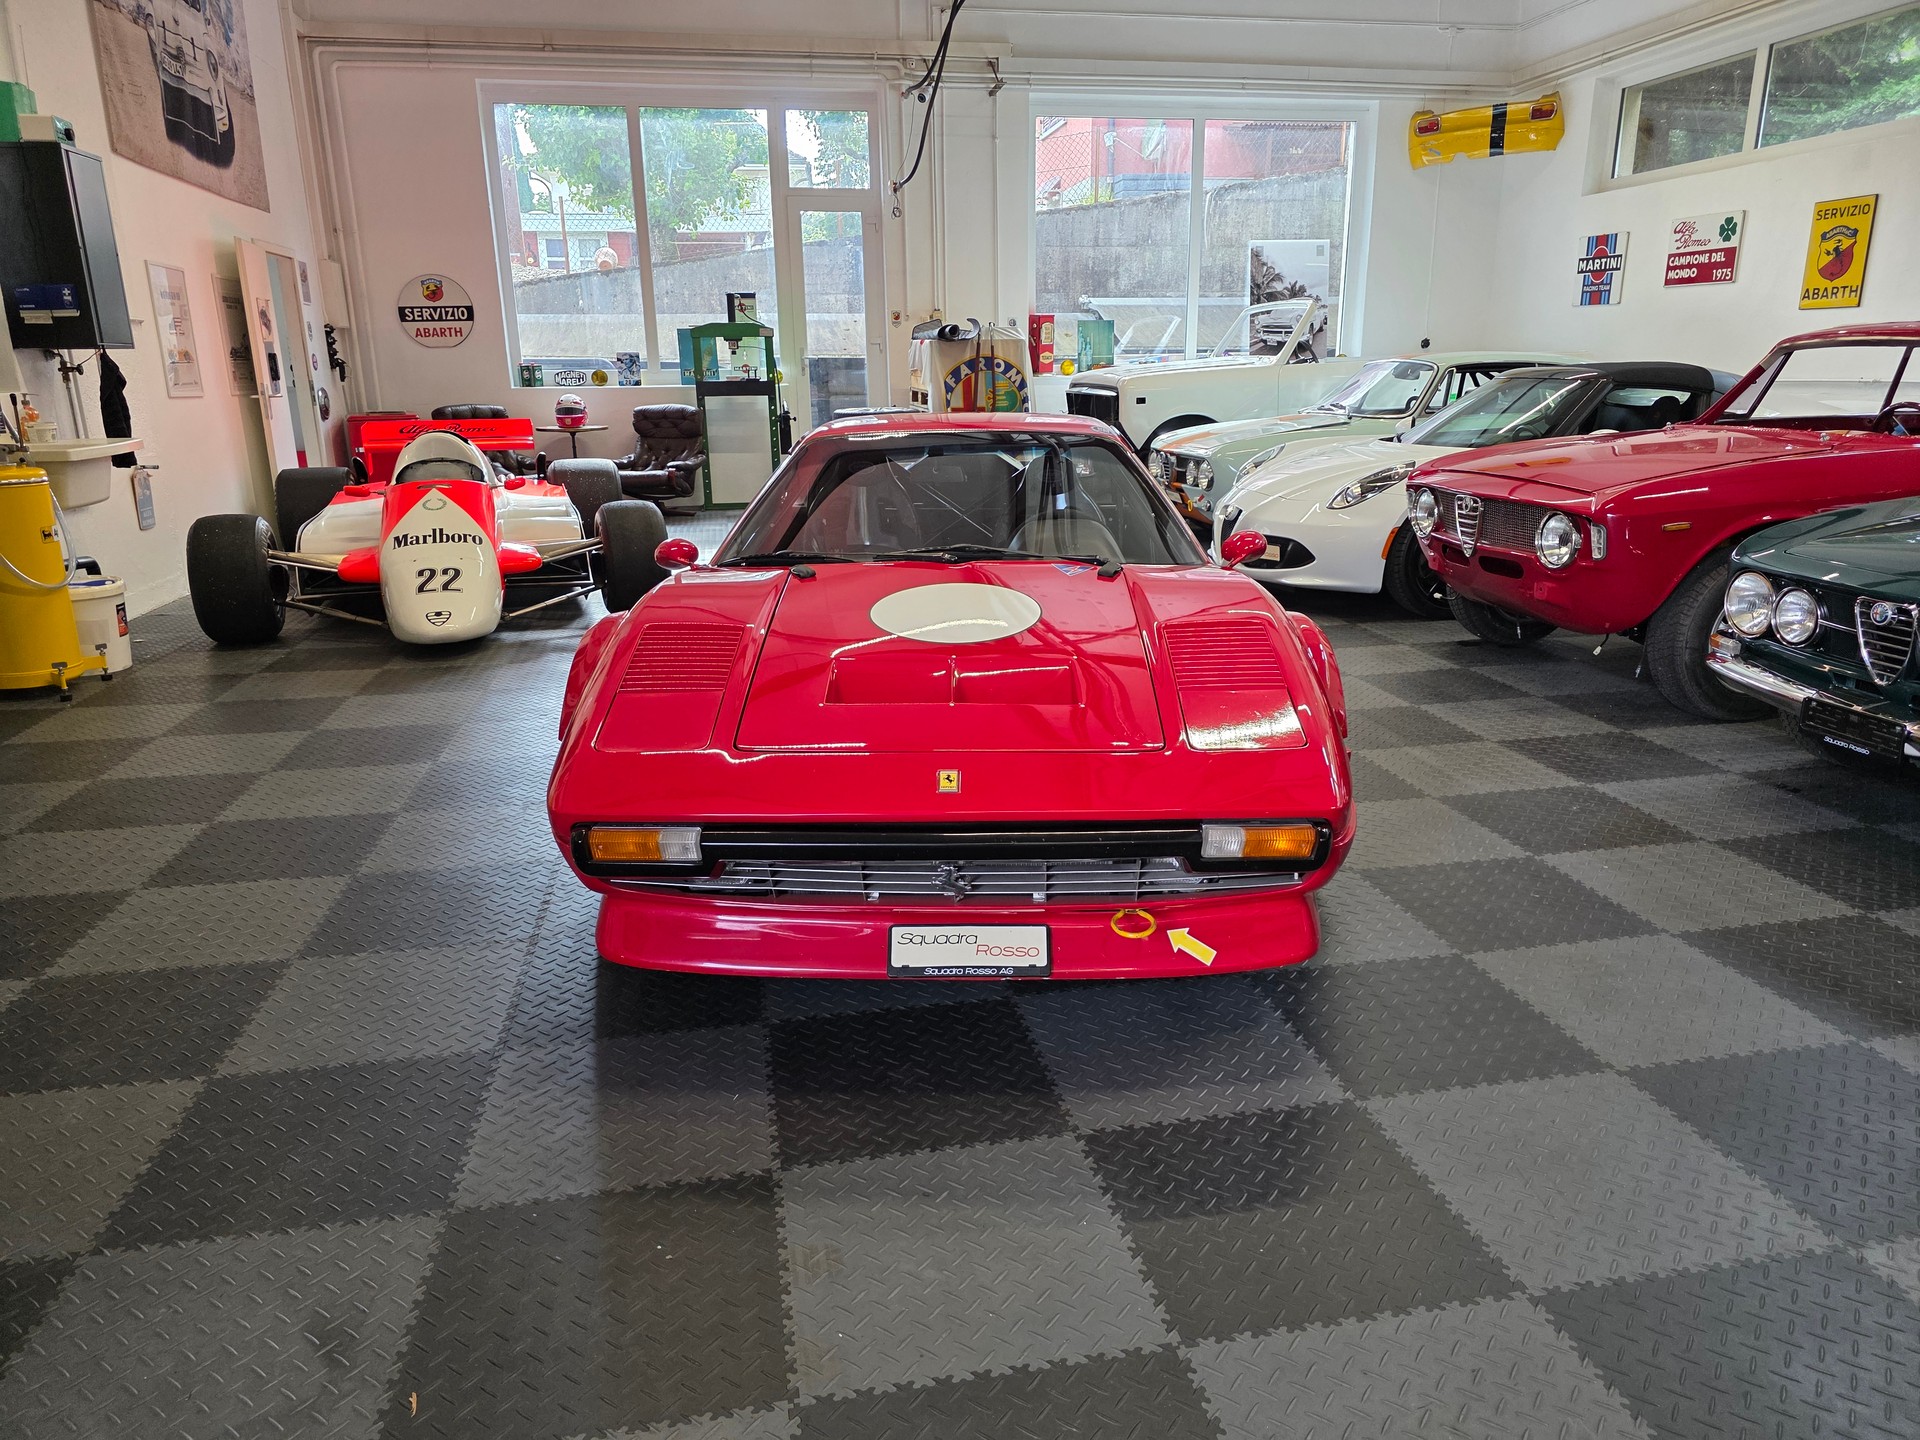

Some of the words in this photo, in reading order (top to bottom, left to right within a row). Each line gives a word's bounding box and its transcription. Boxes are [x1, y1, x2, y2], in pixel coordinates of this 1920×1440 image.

[1816, 203, 1871, 221] SERVIZIO
[1673, 221, 1699, 236] Alfa
[1674, 233, 1711, 250] Romeo
[1578, 255, 1622, 272] MARTINI
[1669, 253, 1710, 267] CAMPIONE
[1711, 251, 1726, 263] DEL
[1667, 267, 1697, 280] MONDO
[1712, 268, 1732, 281] 1975
[1801, 284, 1859, 301] ABARTH
[404, 307, 468, 321] SERVIZIO
[415, 327, 463, 338] ABARTH
[392, 527, 483, 550] Marlboro
[415, 567, 464, 596] 22
[1823, 735, 1849, 749] Squadra
[897, 932, 978, 947] Squadra
[975, 944, 1040, 958] Rosso
[923, 967, 964, 976] Squadra
[965, 967, 998, 975] Rosso
[999, 967, 1014, 975] AG
